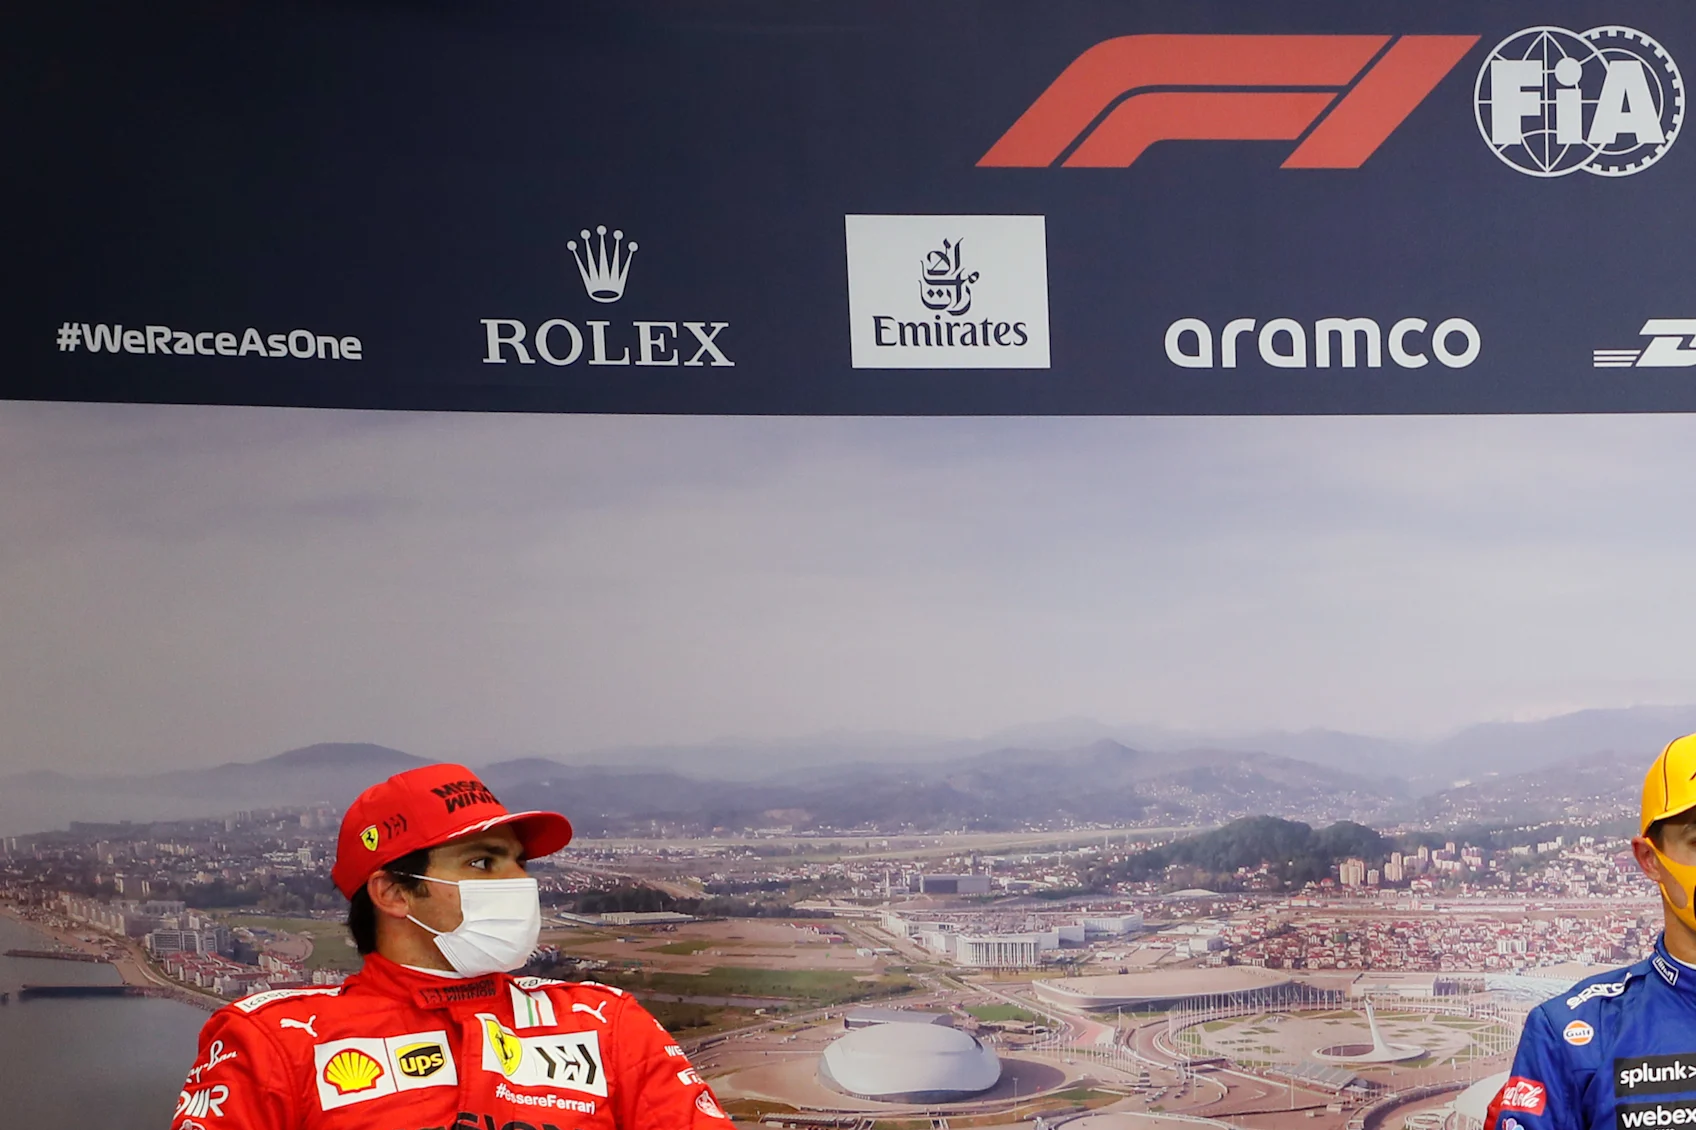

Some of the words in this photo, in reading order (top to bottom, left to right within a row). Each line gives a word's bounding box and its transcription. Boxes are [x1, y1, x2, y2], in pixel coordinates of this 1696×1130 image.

[56, 321, 363, 361] #WeRaceAsOne
[480, 318, 735, 367] ROLEX
[873, 315, 1028, 347] Emirates
[1164, 317, 1480, 368] aramco
[400, 1052, 444, 1076] ups
[495, 1082, 596, 1115] #essereFerrari
